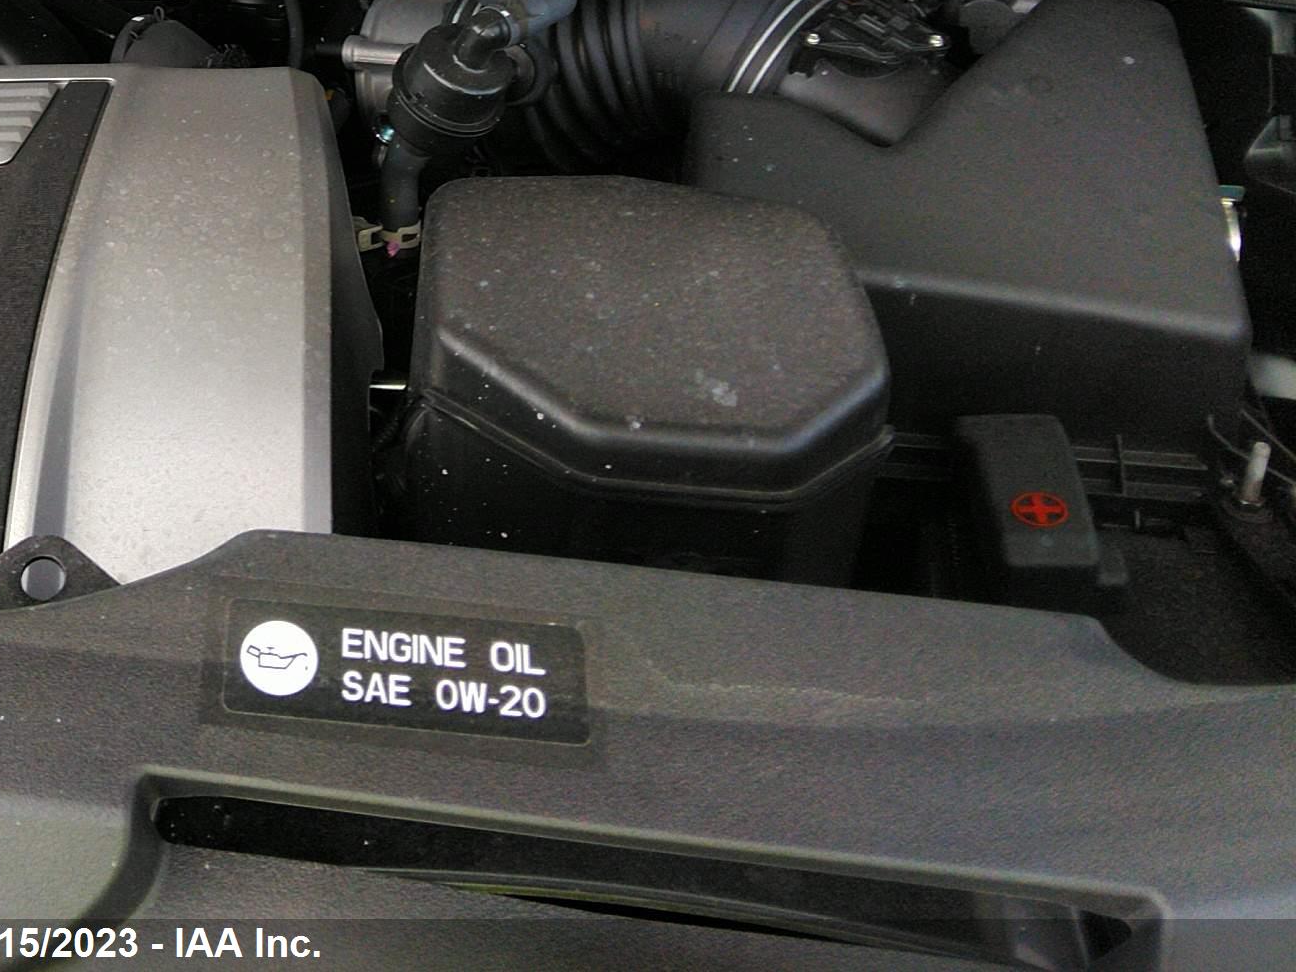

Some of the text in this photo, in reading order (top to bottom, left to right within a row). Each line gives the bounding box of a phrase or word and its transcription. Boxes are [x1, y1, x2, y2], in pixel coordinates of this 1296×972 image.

[341, 627, 547, 676] ENGINE OIL
[341, 670, 547, 720] SAE 0W-20
